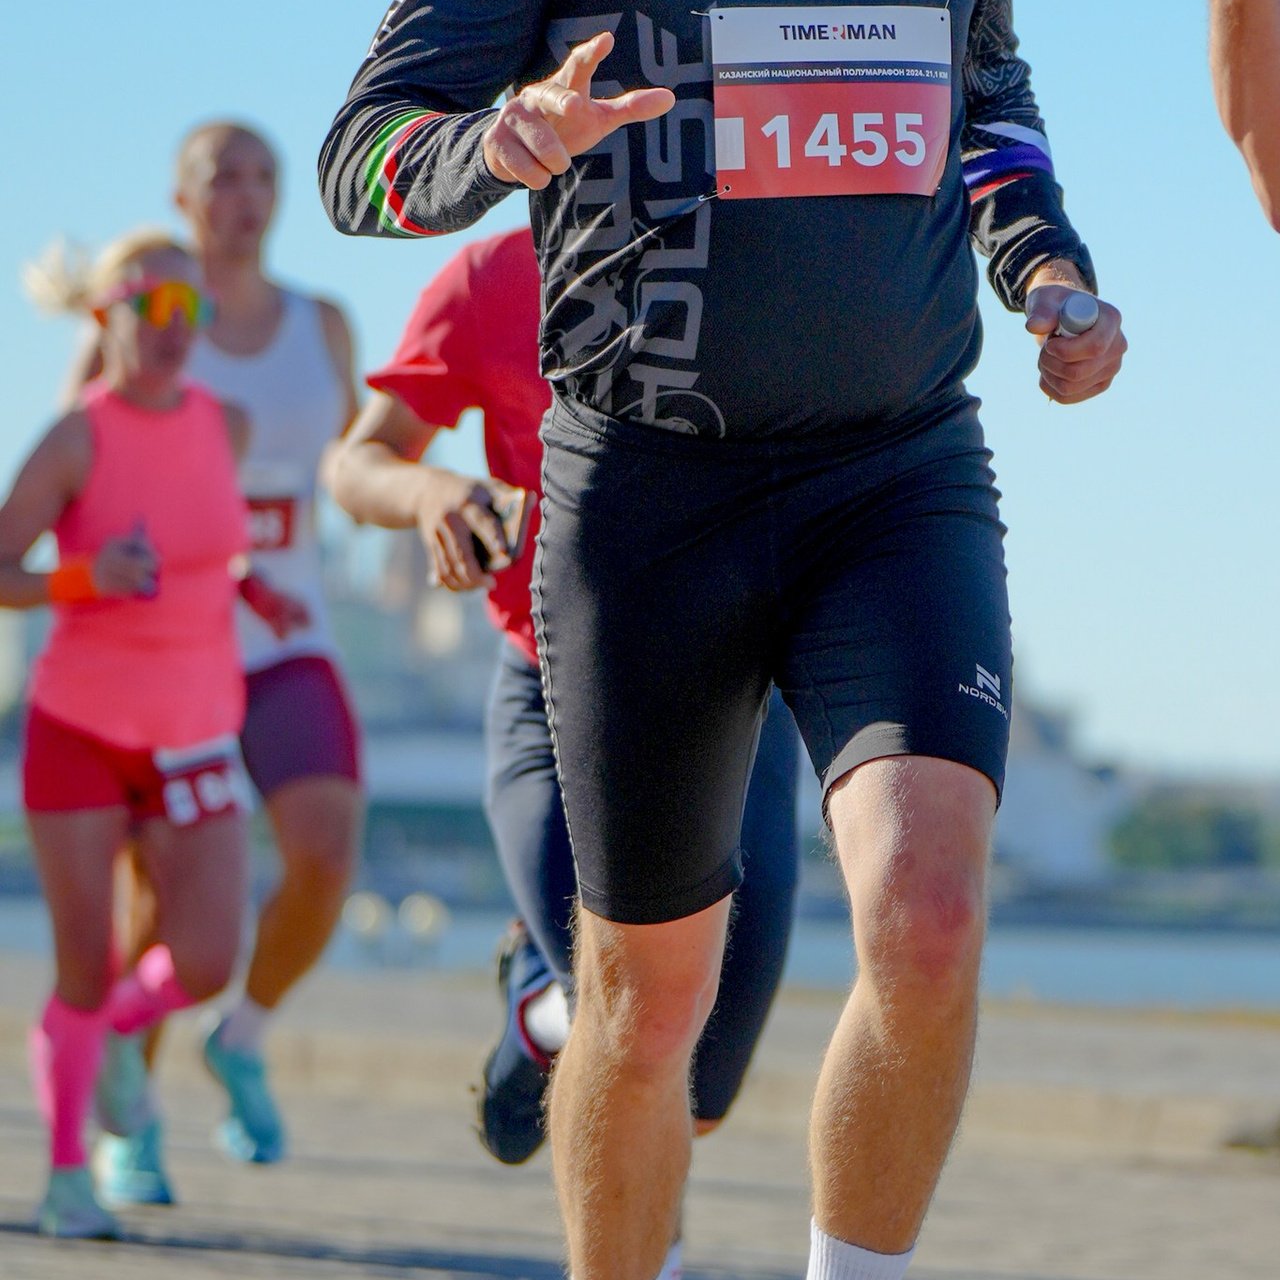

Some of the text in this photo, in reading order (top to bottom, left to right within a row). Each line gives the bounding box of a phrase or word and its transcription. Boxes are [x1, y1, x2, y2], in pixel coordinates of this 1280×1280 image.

[719, 68, 770, 79] КАЗАНСКИЙ
[771, 67, 842, 78] НАЦИОНАЛЬНЫЙ
[843, 68, 905, 77] ПОЛУМАРАФОН
[761, 112, 926, 168] 1455
